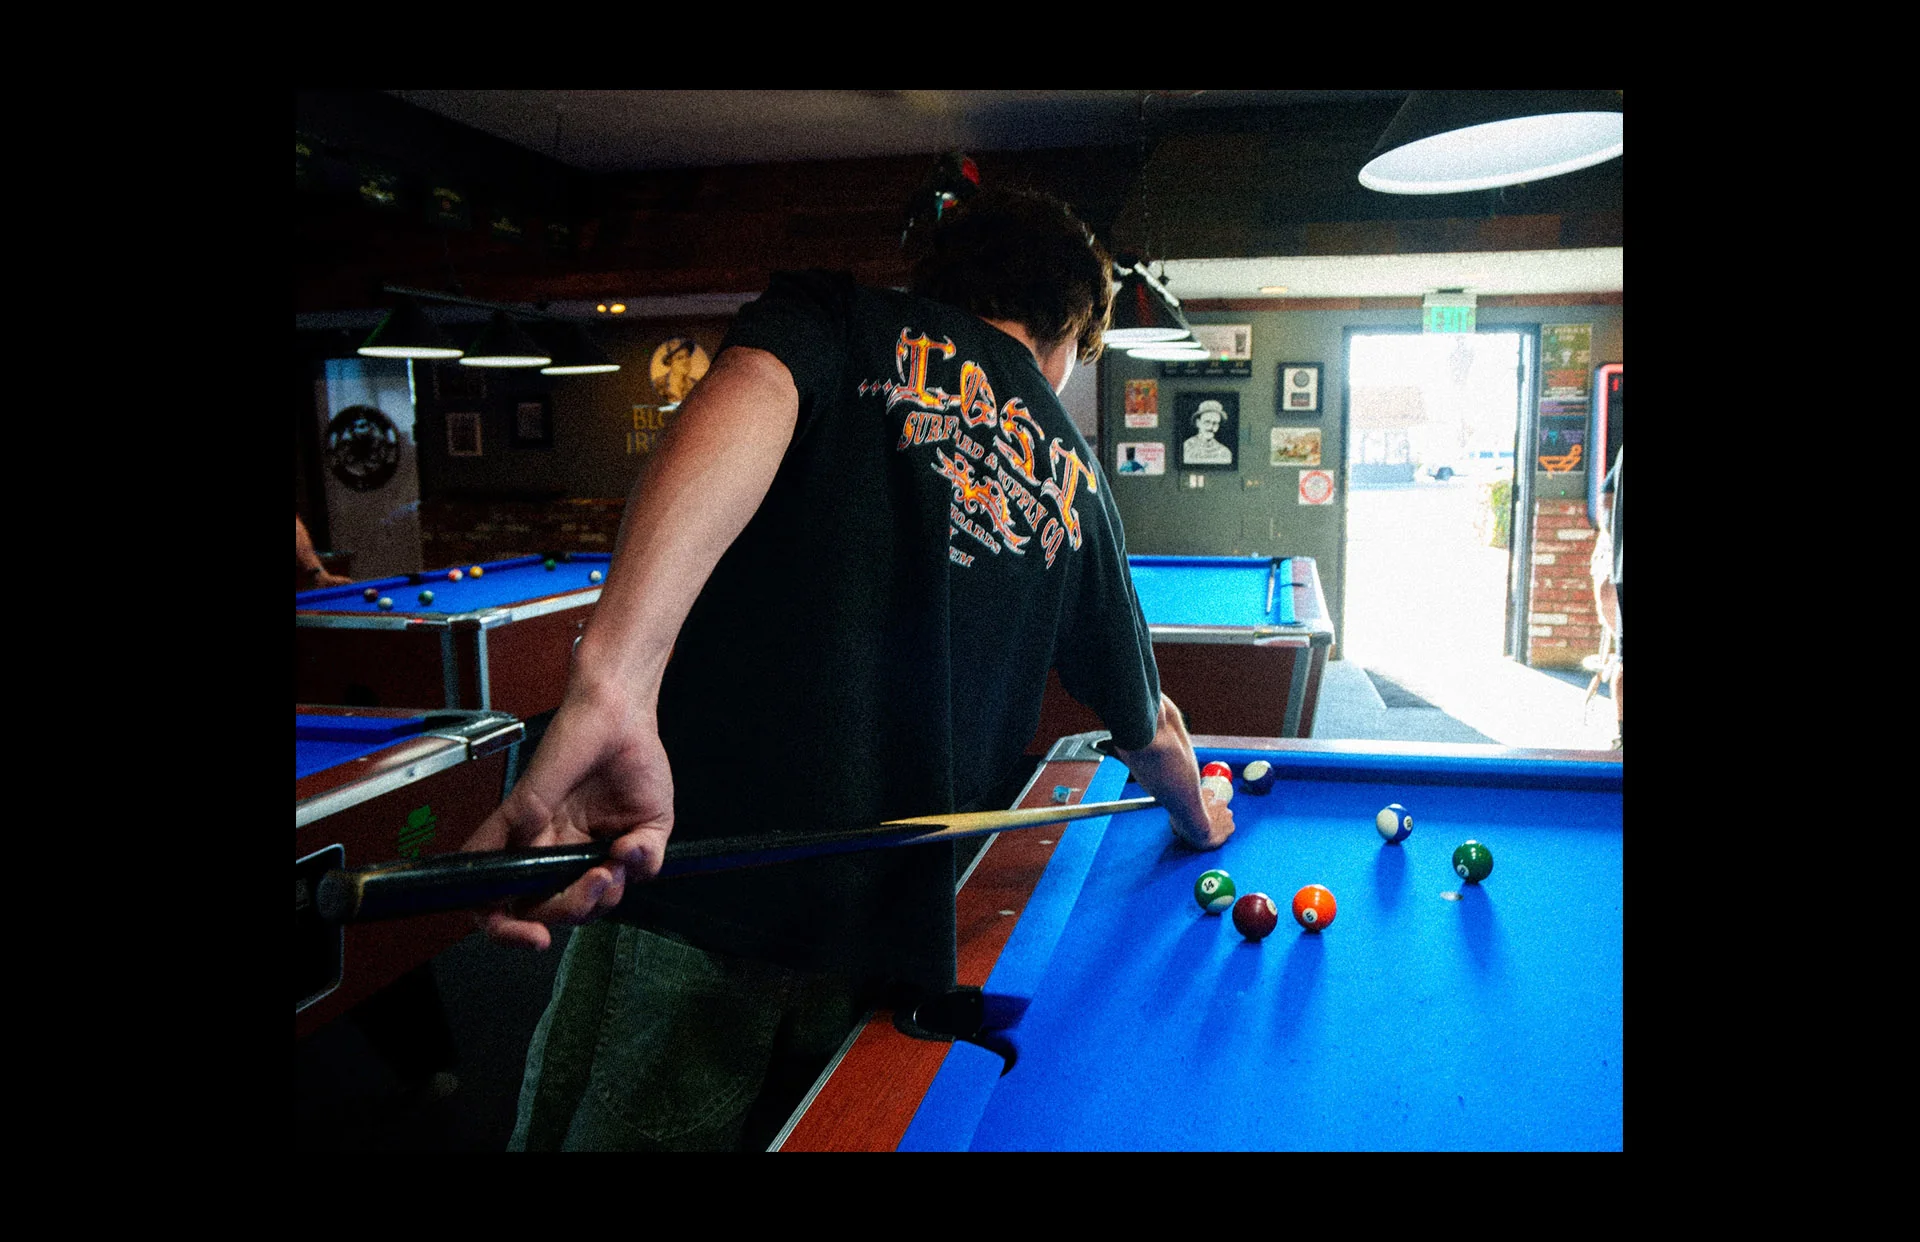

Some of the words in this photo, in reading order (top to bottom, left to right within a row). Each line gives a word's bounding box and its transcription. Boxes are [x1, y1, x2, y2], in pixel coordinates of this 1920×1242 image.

[1431, 306, 1469, 332] EXIT
[1203, 879, 1215, 892] 14
[1305, 911, 1314, 922] 5
